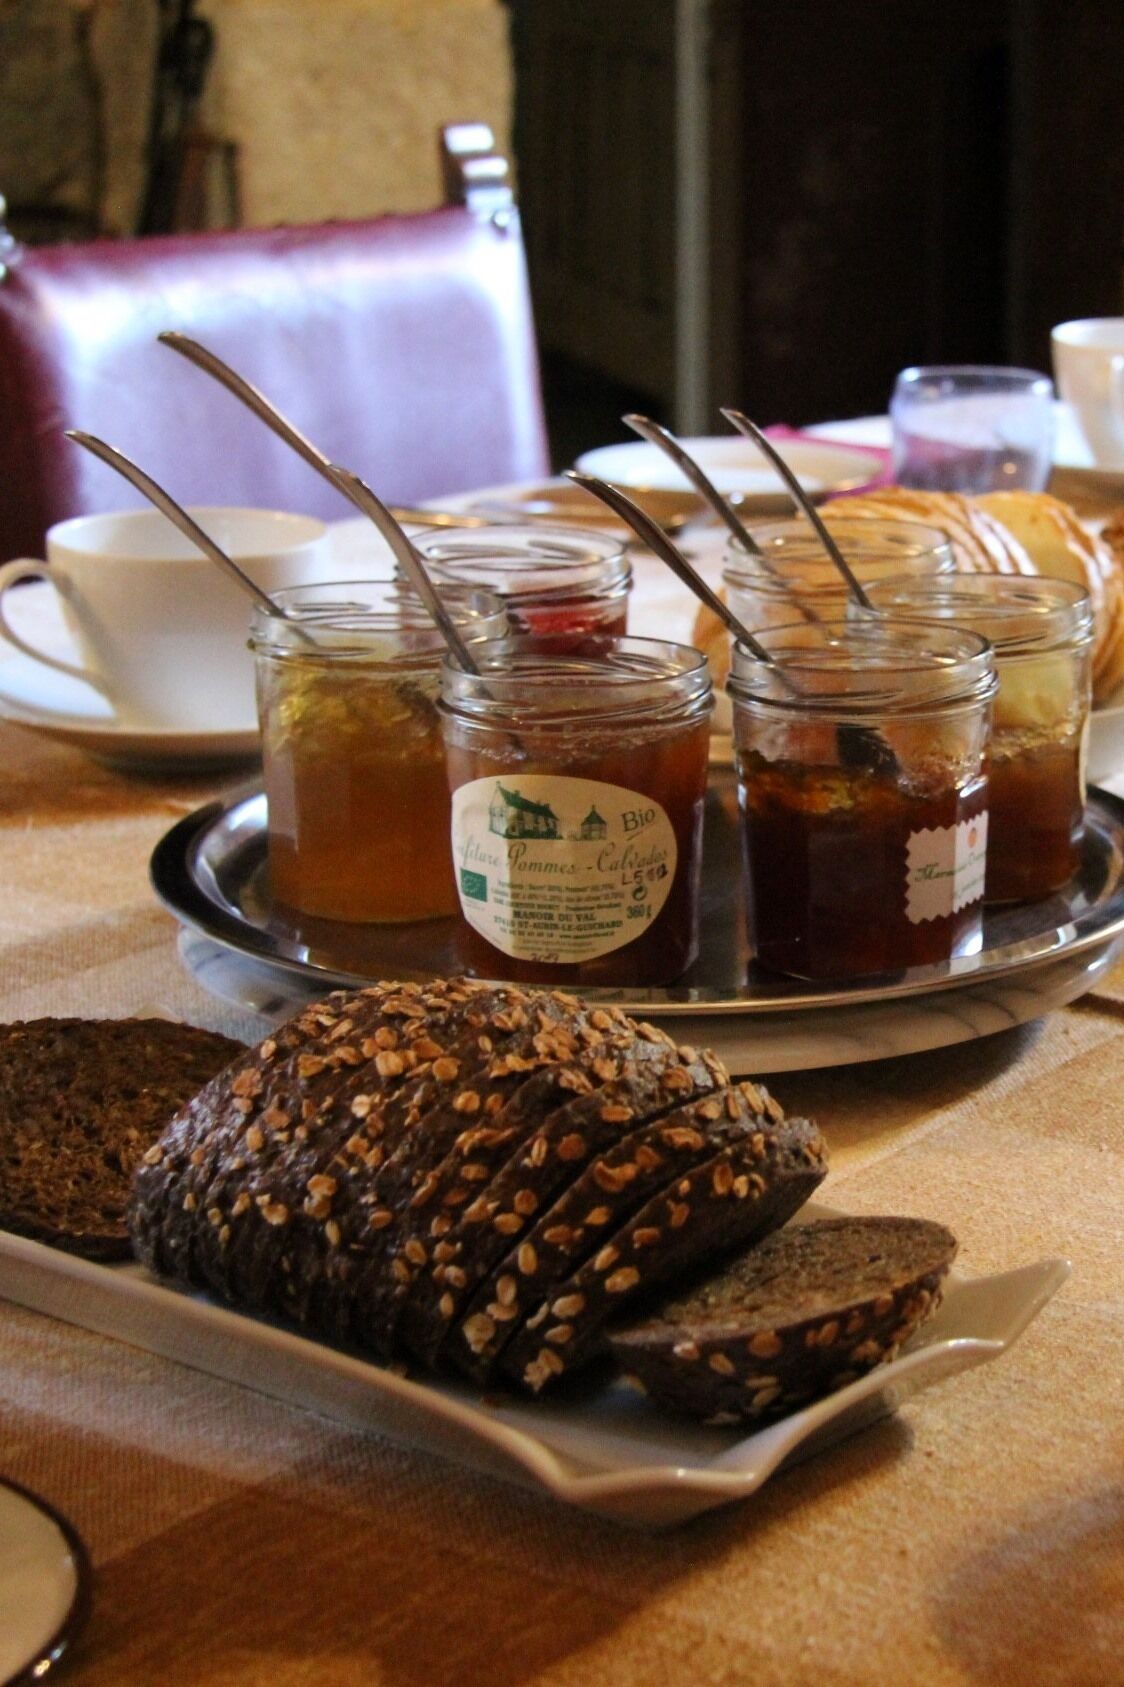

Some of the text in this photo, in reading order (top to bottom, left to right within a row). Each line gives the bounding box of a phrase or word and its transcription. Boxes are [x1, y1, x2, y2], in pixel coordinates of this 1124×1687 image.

[621, 808, 656, 833] Bio
[507, 842, 576, 874] Pommes
[597, 842, 668, 873] Calvados
[512, 910, 597, 922] MANOIR DU VAL
